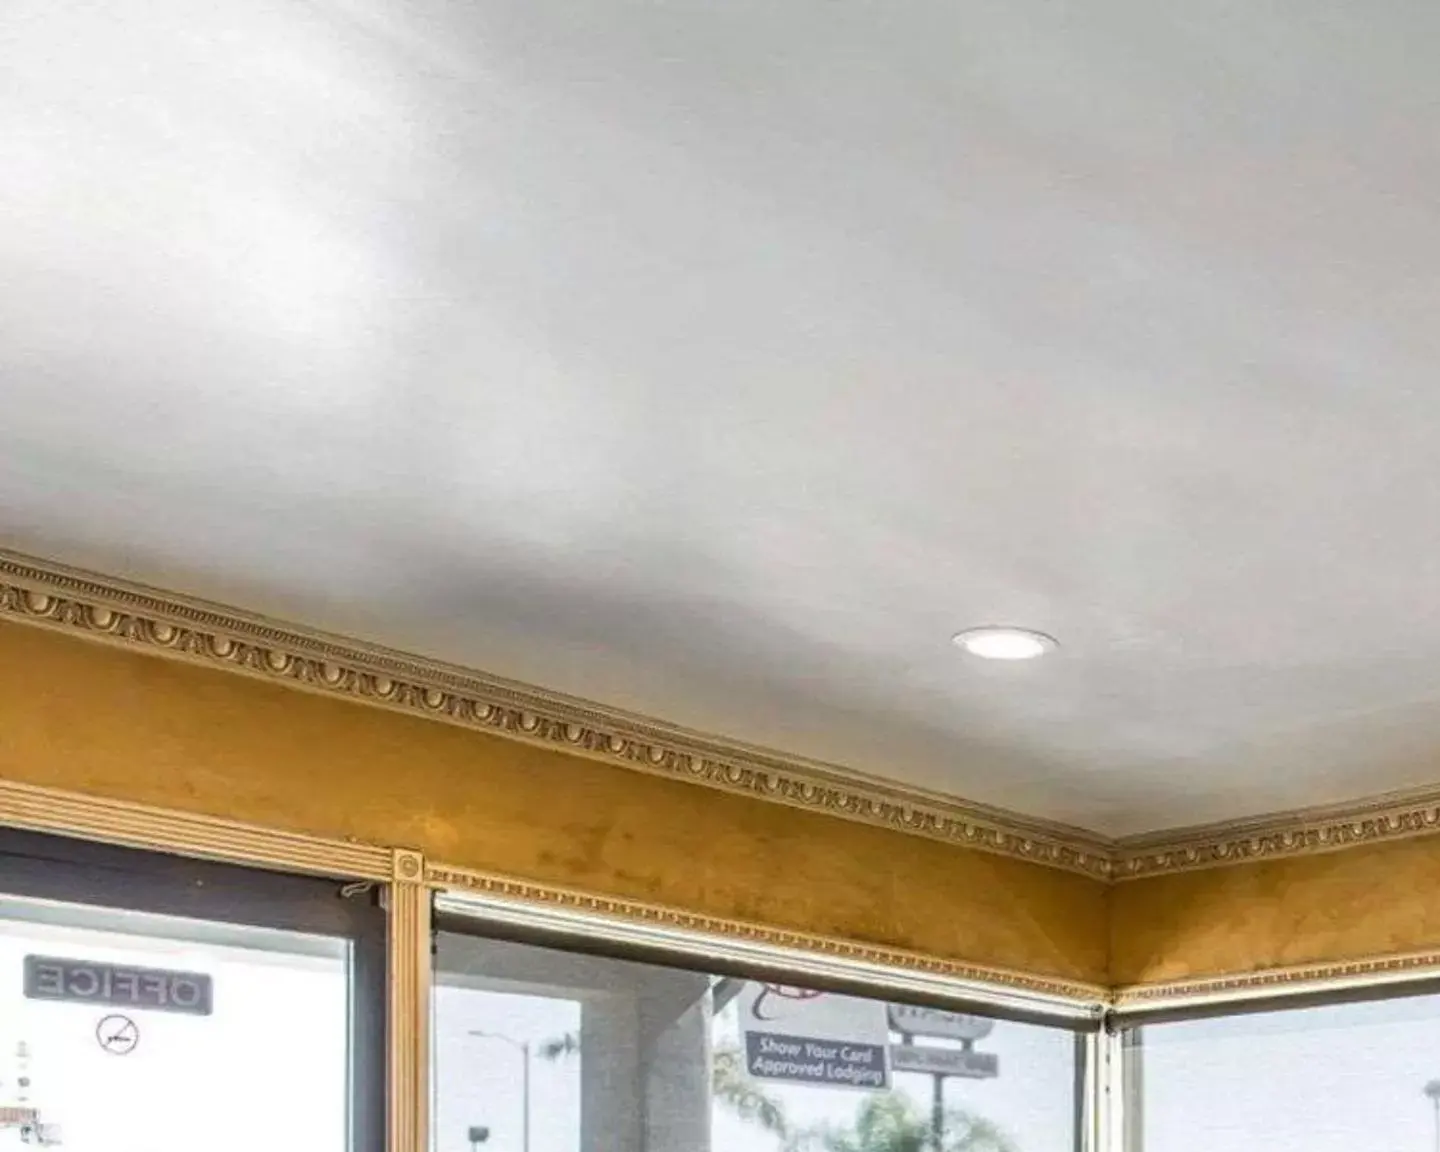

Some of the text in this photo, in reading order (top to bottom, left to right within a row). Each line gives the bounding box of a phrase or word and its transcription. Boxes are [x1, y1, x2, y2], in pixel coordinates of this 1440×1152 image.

[759, 1037, 873, 1063] Show Your Card
[751, 1056, 825, 1077] Approved
[827, 1062, 883, 1085] Lodging
